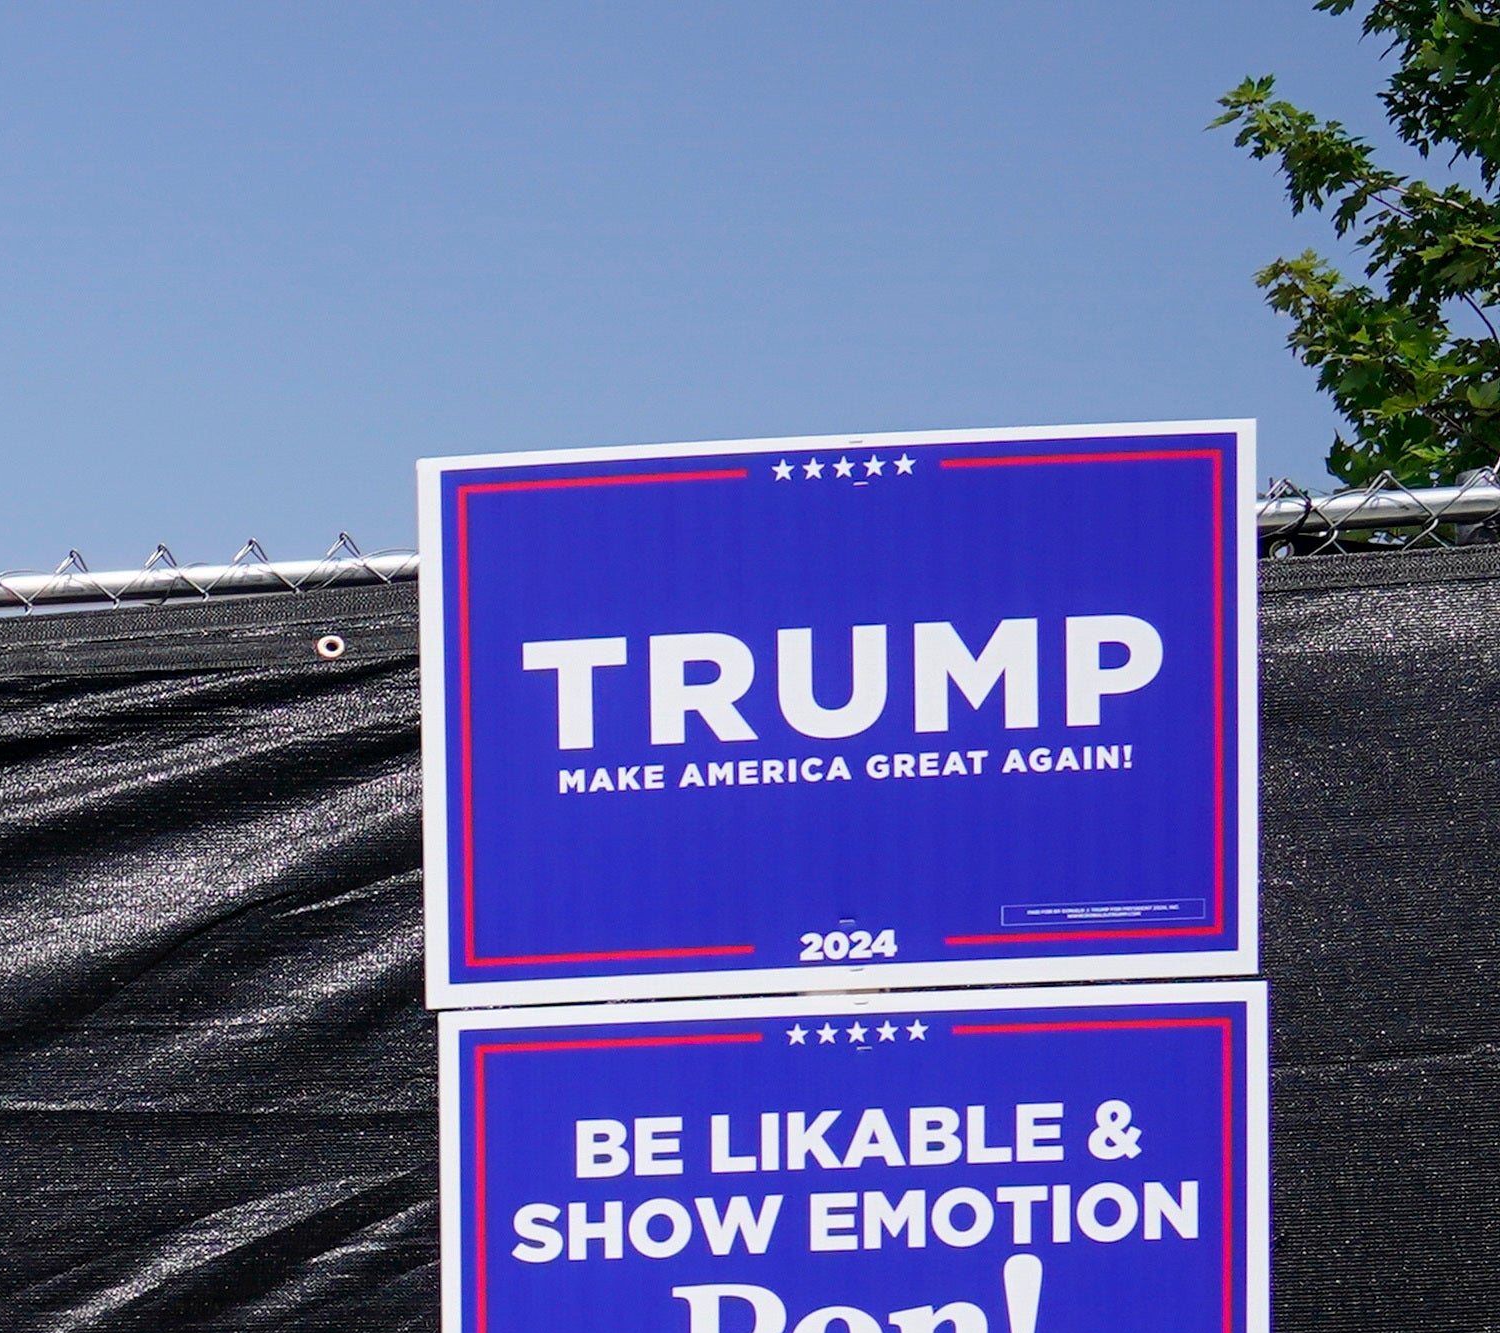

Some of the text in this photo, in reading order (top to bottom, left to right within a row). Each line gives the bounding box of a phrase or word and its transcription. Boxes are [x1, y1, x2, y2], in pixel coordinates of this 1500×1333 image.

[522, 614, 1164, 750] TRUMP
[558, 745, 1133, 794] MAKE AMERICA GREAT AGAIN!
[799, 929, 898, 961] 2024
[575, 1099, 1142, 1179] BE LIKABLE &
[511, 1180, 1199, 1263] SHOW EMOTION
